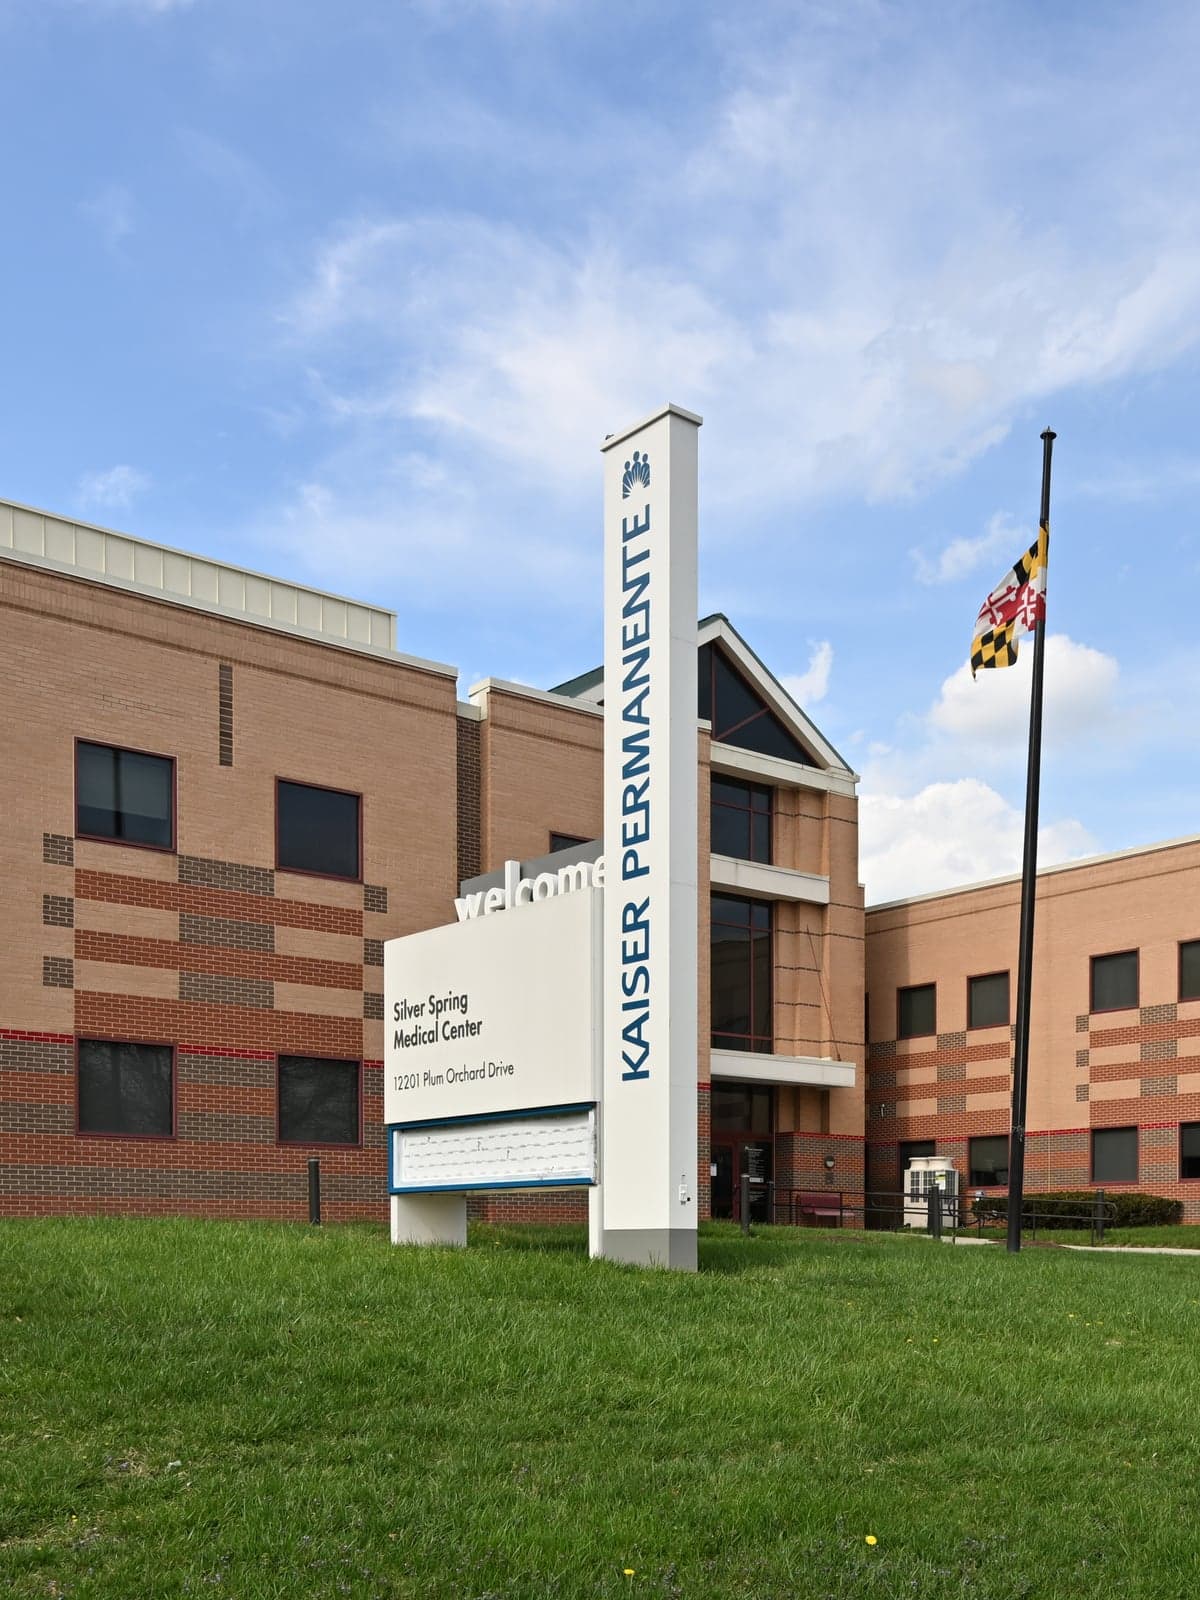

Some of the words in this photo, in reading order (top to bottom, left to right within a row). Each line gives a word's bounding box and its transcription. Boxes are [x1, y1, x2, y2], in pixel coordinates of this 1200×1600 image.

[621, 503, 650, 881] PERMANENTE
[454, 855, 606, 921] welcome
[393, 998, 425, 1022] Silver
[428, 990, 468, 1020] Spring
[621, 895, 650, 1082] KAISER
[393, 1020, 439, 1050] Medical
[441, 1019, 482, 1042] Center
[394, 1073, 420, 1091] 12201
[423, 1069, 443, 1087] Plum
[446, 1061, 485, 1084] Orchard
[488, 1060, 514, 1078] Drive
